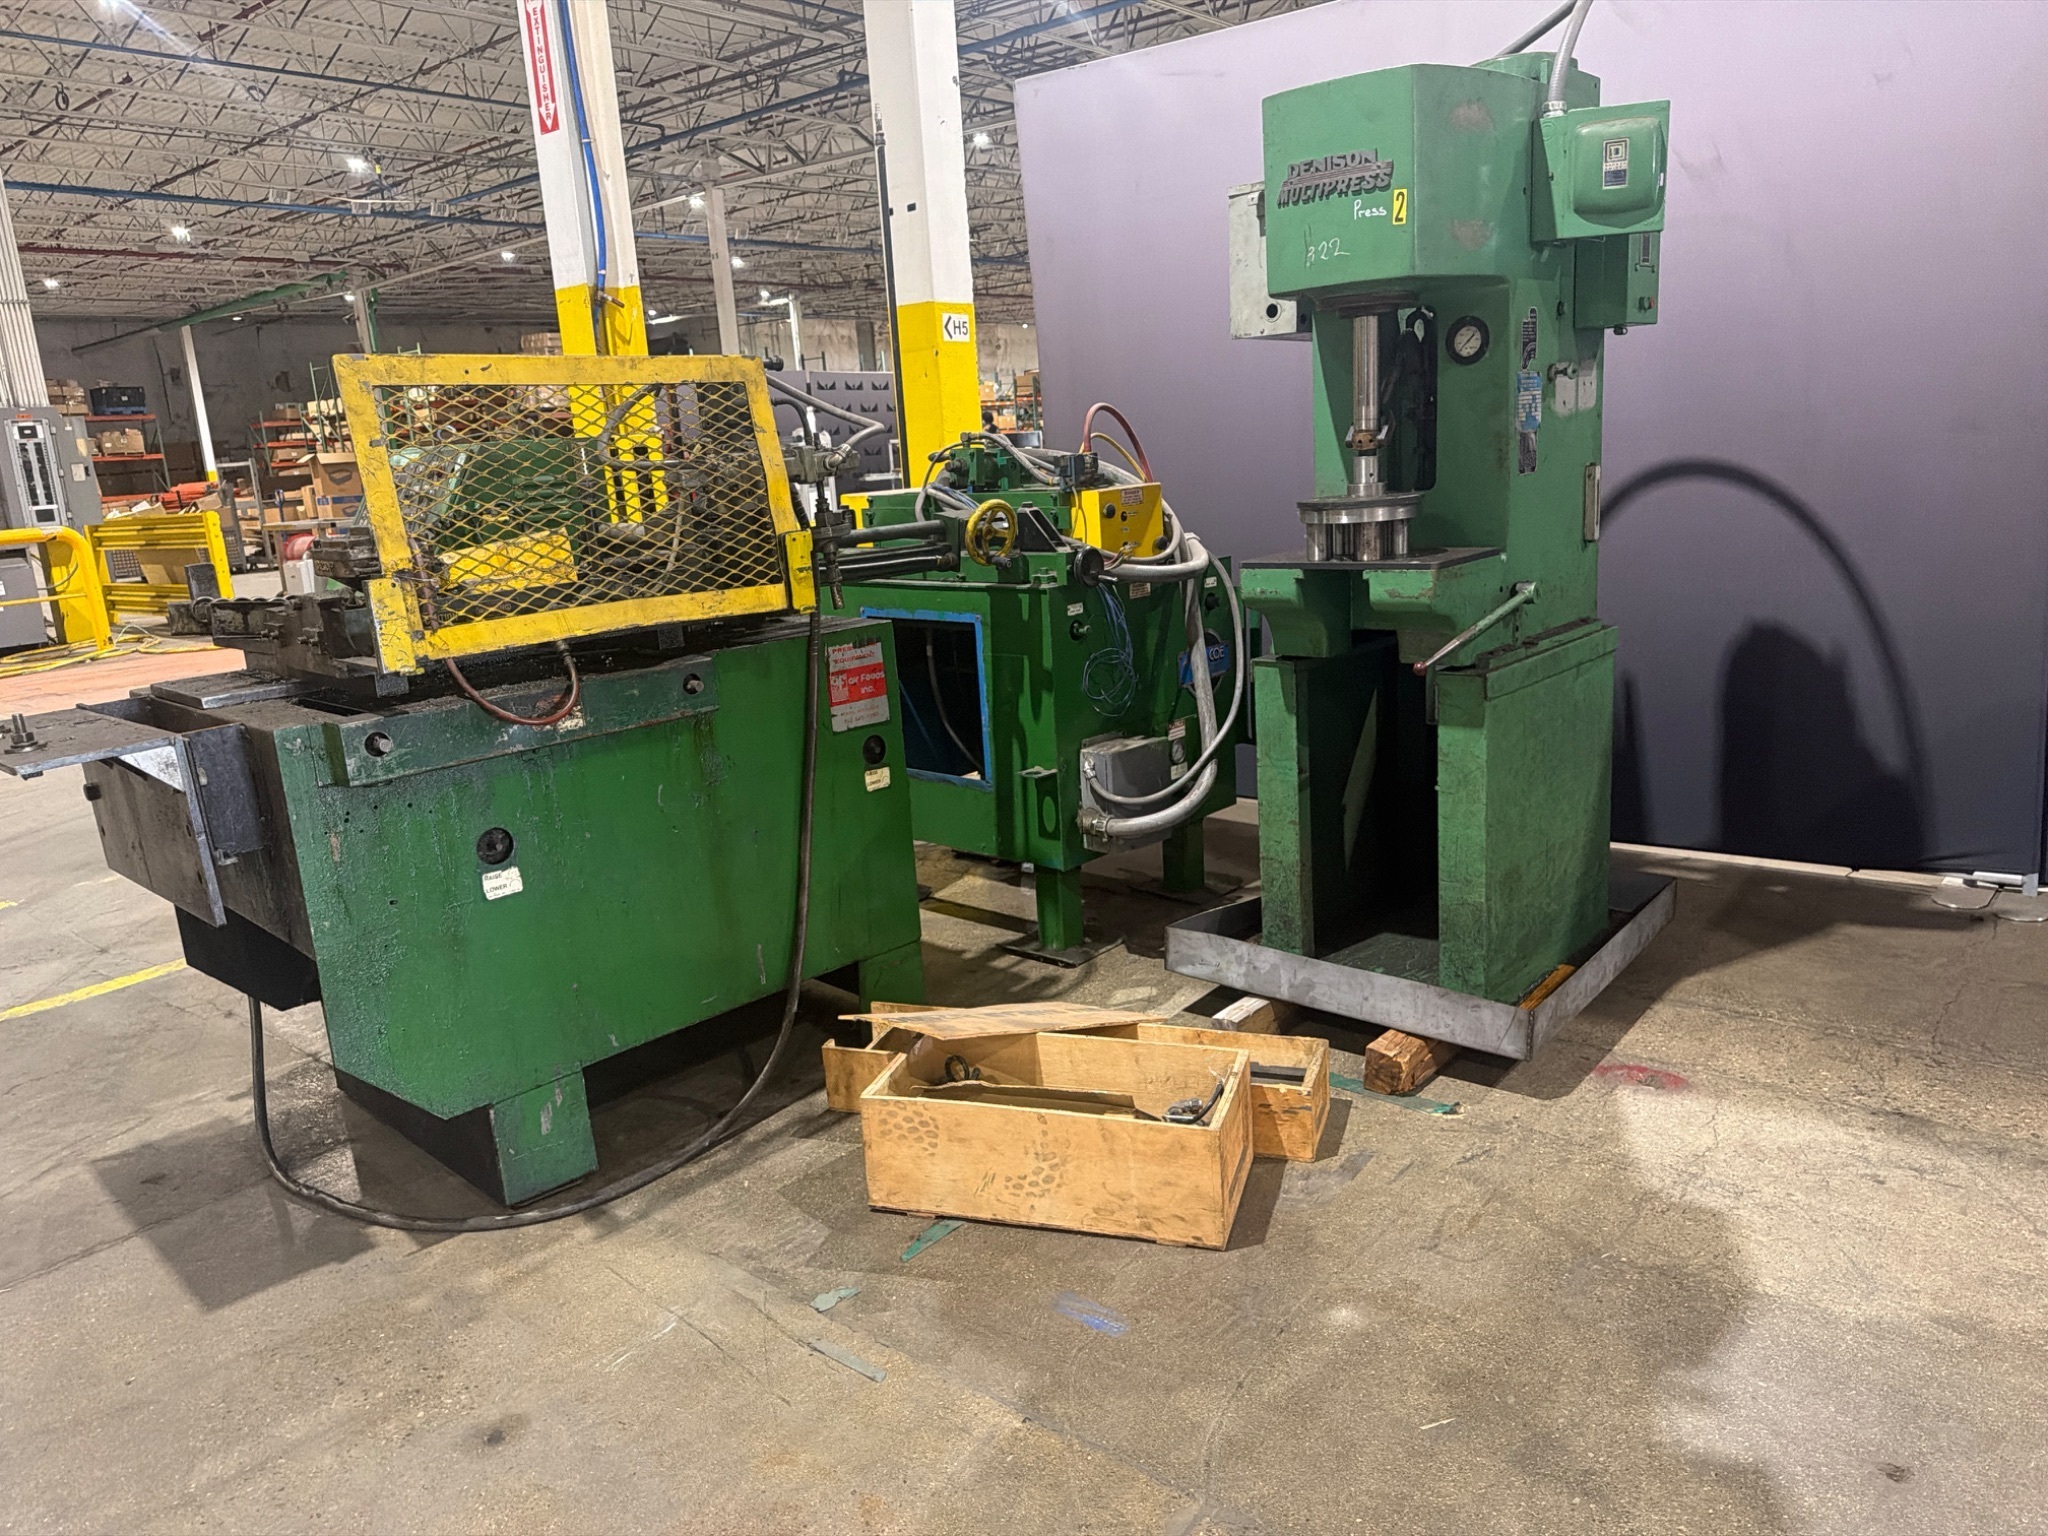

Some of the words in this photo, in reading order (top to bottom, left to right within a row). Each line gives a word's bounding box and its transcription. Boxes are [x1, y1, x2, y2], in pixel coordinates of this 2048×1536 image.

[532, 7, 552, 120] EXTINGUISHER
[1287, 150, 1378, 178] DENISON
[1278, 168, 1393, 208] MULTIPRESS
[1354, 199, 1387, 220] Press
[1394, 191, 1406, 222] 2
[953, 320, 969, 335] H5
[484, 873, 502, 881] RAISE
[486, 883, 508, 893] LOWER
